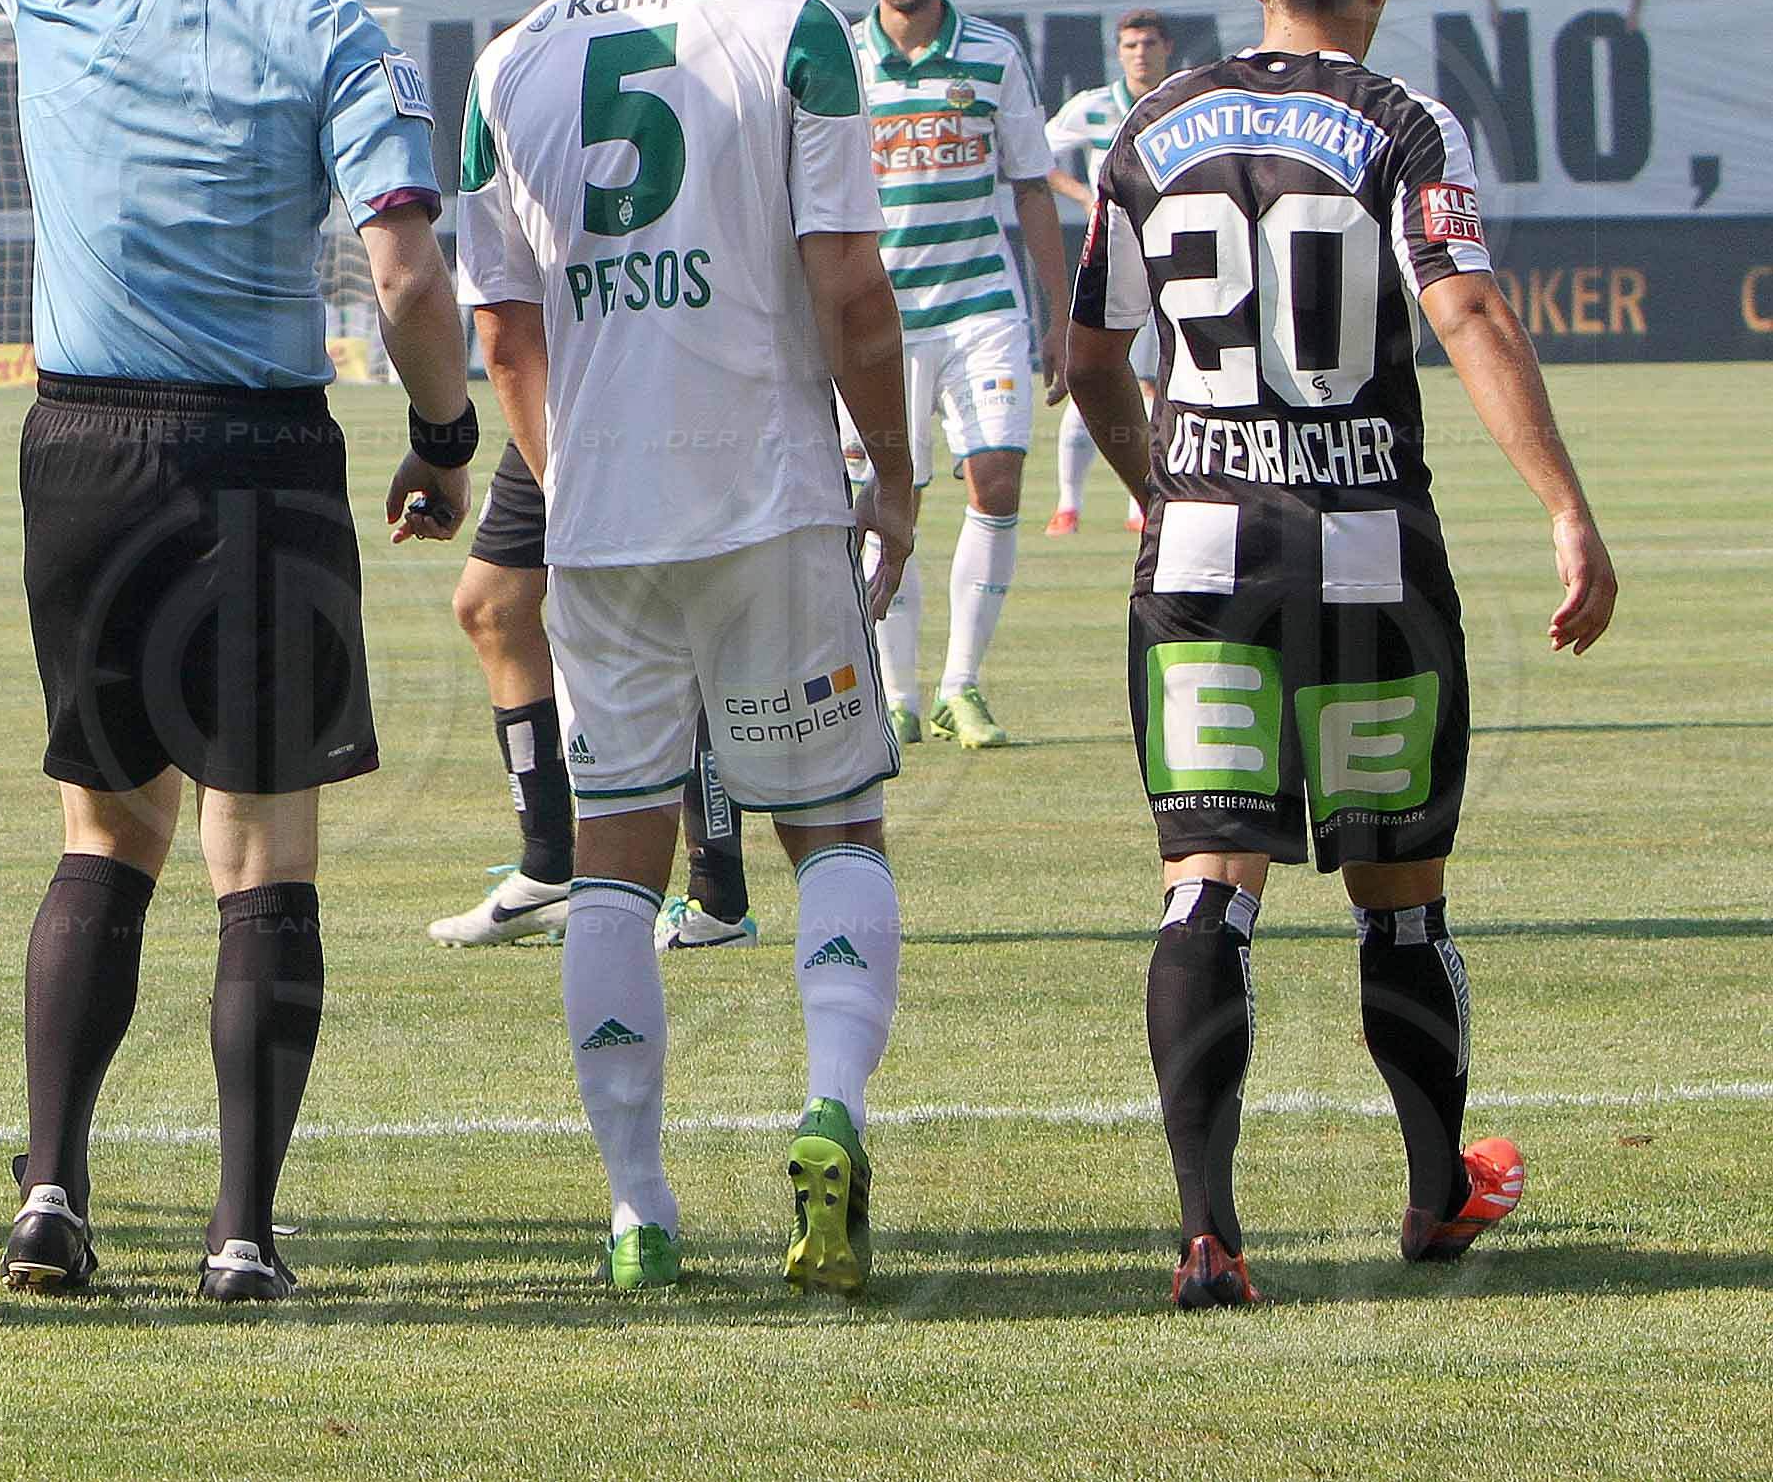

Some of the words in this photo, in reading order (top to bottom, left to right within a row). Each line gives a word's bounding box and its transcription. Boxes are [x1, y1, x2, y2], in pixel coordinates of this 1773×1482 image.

[581, 22, 686, 238] 5
[1145, 103, 1366, 168] PUNTIGAMER
[1141, 191, 1381, 408] 20
[725, 688, 793, 717] card
[730, 696, 864, 744] complete
[1163, 662, 1265, 772] E
